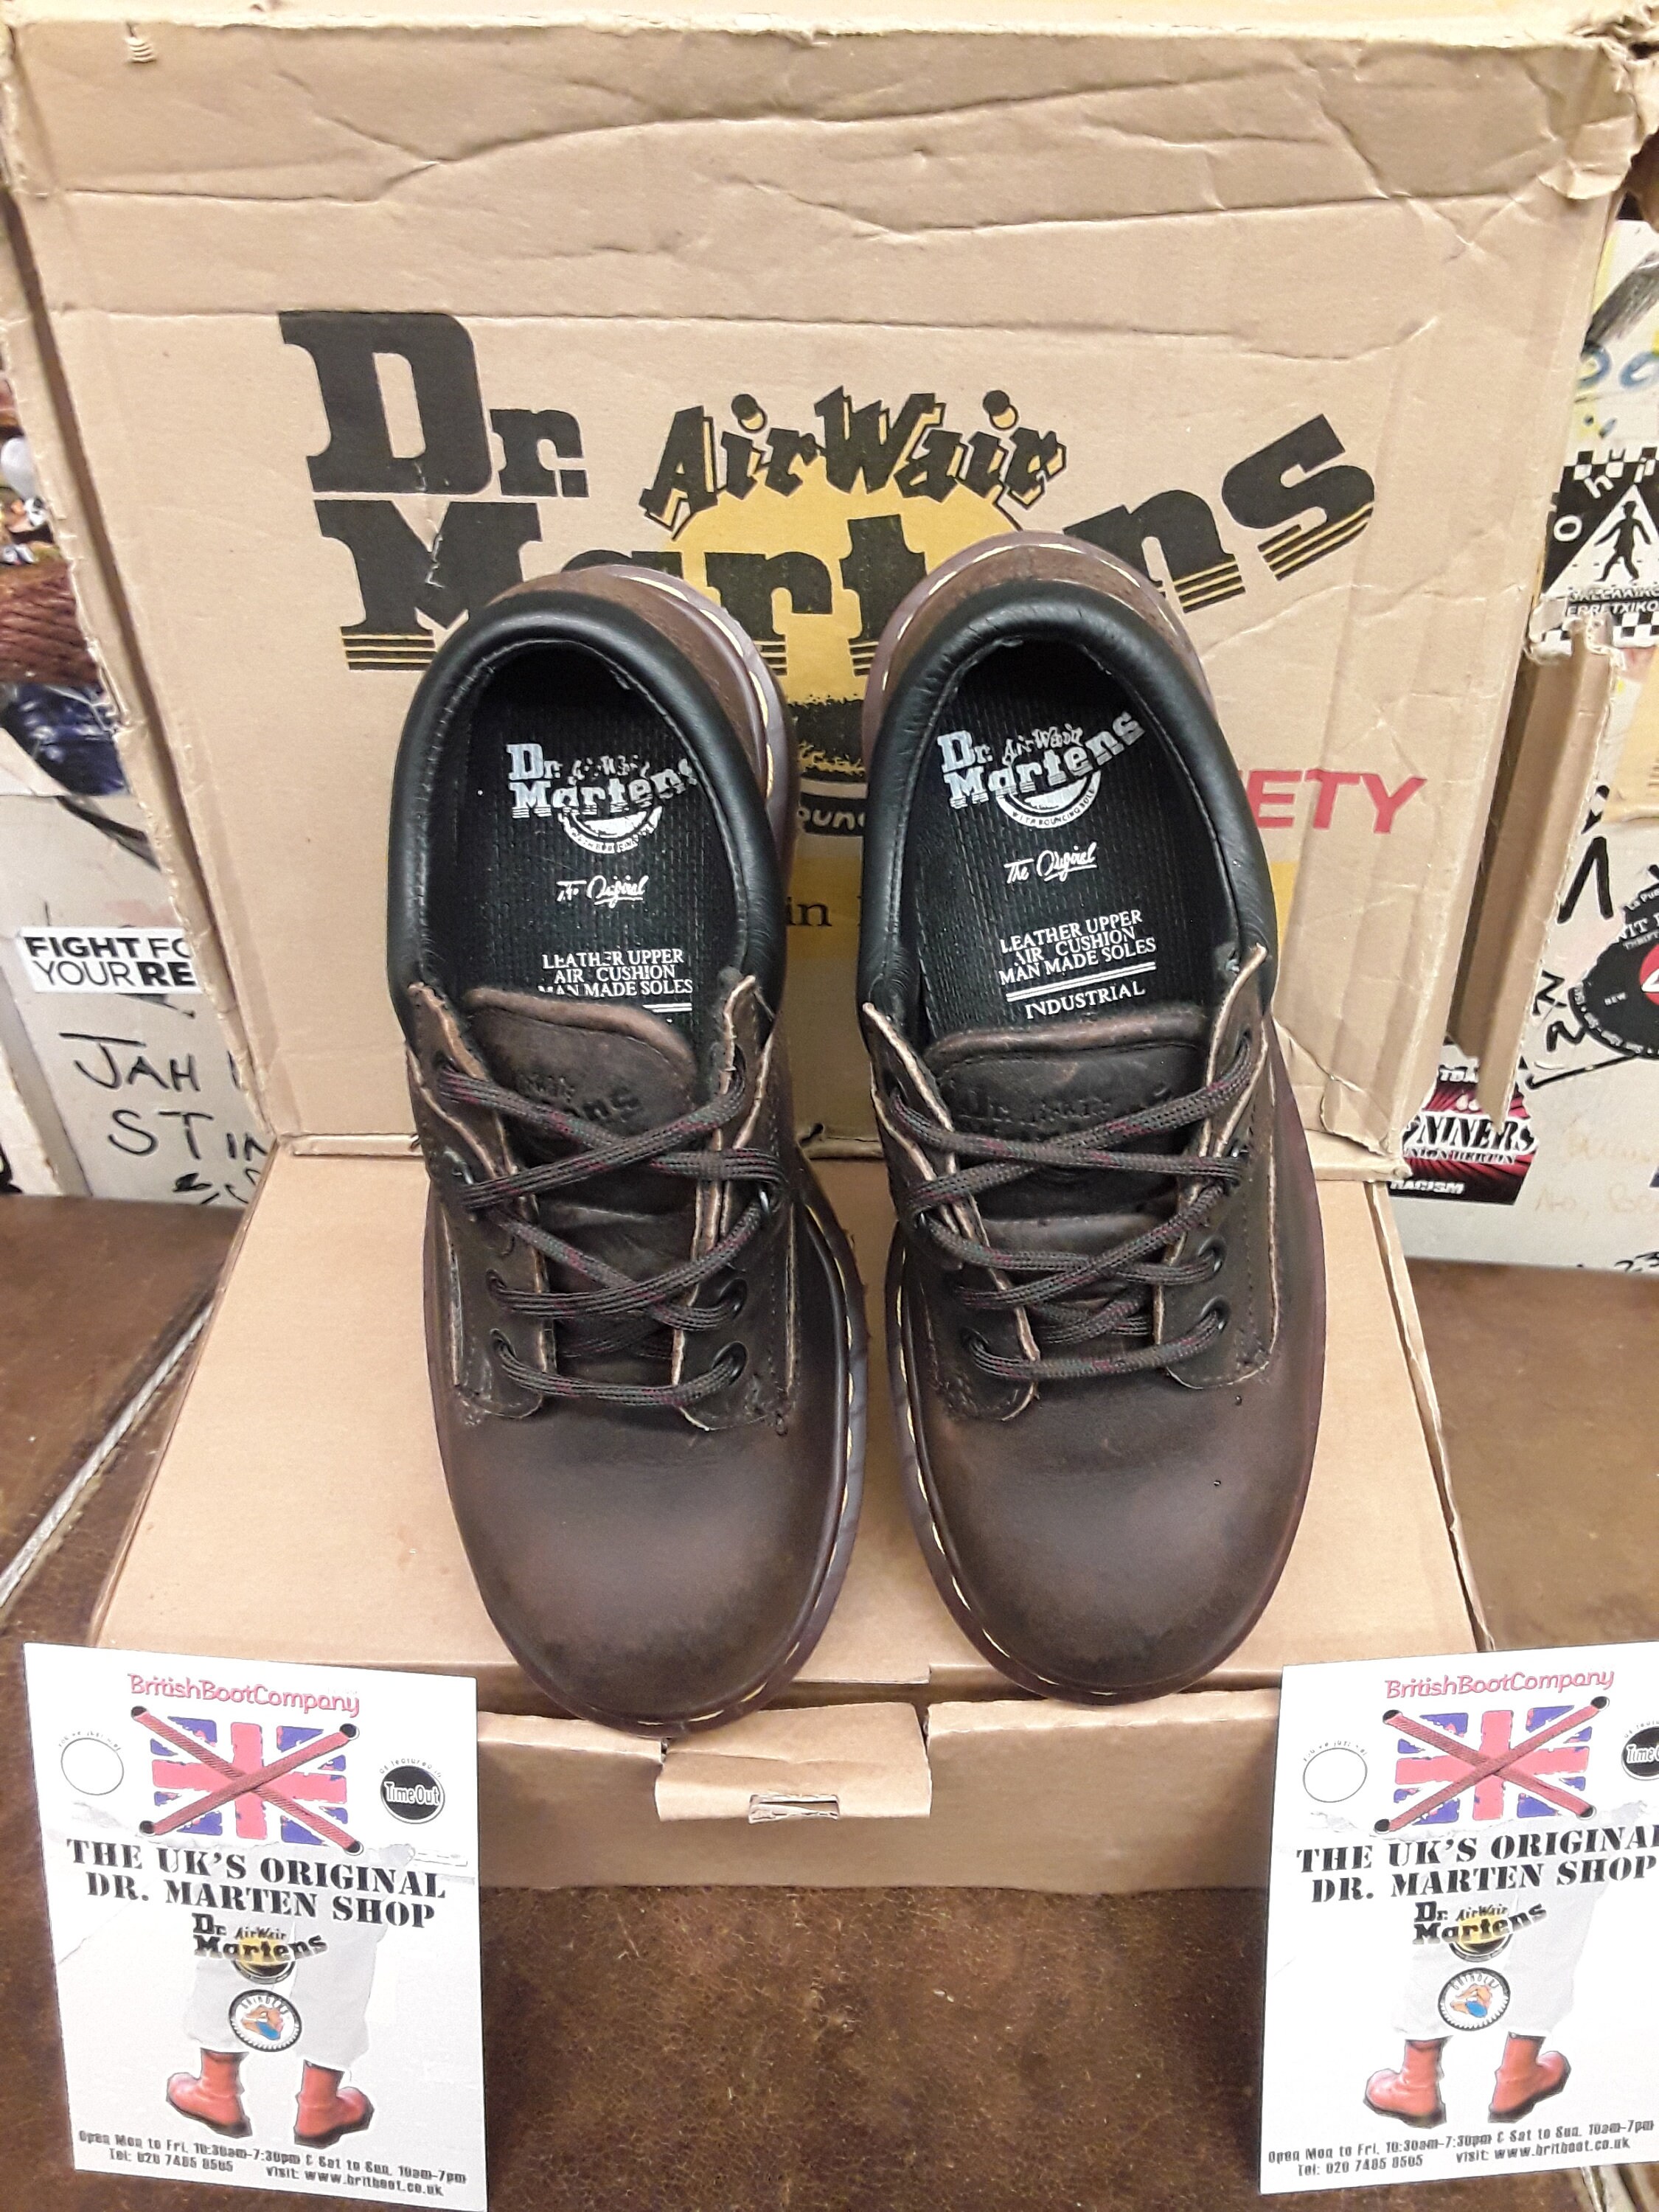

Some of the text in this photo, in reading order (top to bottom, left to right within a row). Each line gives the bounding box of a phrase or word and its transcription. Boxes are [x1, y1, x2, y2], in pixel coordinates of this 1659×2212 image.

[279, 310, 589, 497] Dr.
[639, 385, 1067, 540] AirWair
[506, 742, 563, 779] Dr.
[937, 730, 993, 773] Dr.
[944, 710, 1145, 809] Martens
[1238, 769, 1427, 834] ETY
[24, 936, 141, 959] FIGHT
[1000, 909, 1143, 953] LEATHER UPPER
[1015, 926, 1136, 966] AIR CUSHION
[34, 961, 138, 987] YOUR
[542, 948, 684, 970] LEATHER UPPER
[554, 964, 676, 984] AIR CUSHION
[998, 936, 1157, 986] MAN MADE SOLES
[584, 981, 638, 998] MADE
[639, 978, 694, 995] SOLES
[1025, 980, 1146, 1020] INDUSTRIAL
[59, 1032, 201, 1091] JAH
[127, 1672, 361, 1718] BritishBootCompany
[1384, 1671, 1615, 1699] BritishBootCompany
[66, 1838, 446, 1899] THE UK'S ORIGINAL
[1296, 1845, 1373, 1873] THE
[1388, 1837, 1478, 1867] UK'S
[1311, 1854, 1657, 1903] DR. MARTEN SHOP
[86, 1871, 435, 1928] DR. MARTEN SHOP
[1413, 1901, 1448, 1922] Dr.
[192, 1913, 227, 1935] Dr.
[1412, 1902, 1548, 1945] Martens
[192, 1934, 329, 1962] Martens
[79, 2129, 111, 2145] Open
[115, 2134, 143, 2149] Mon
[149, 2138, 161, 2150] to
[1268, 2150, 1300, 2164] Open
[1305, 2147, 1333, 2160] Mon
[1339, 2145, 1352, 2157] to
[1510, 2129, 1531, 2143] Sat
[1538, 2127, 1551, 2140] to
